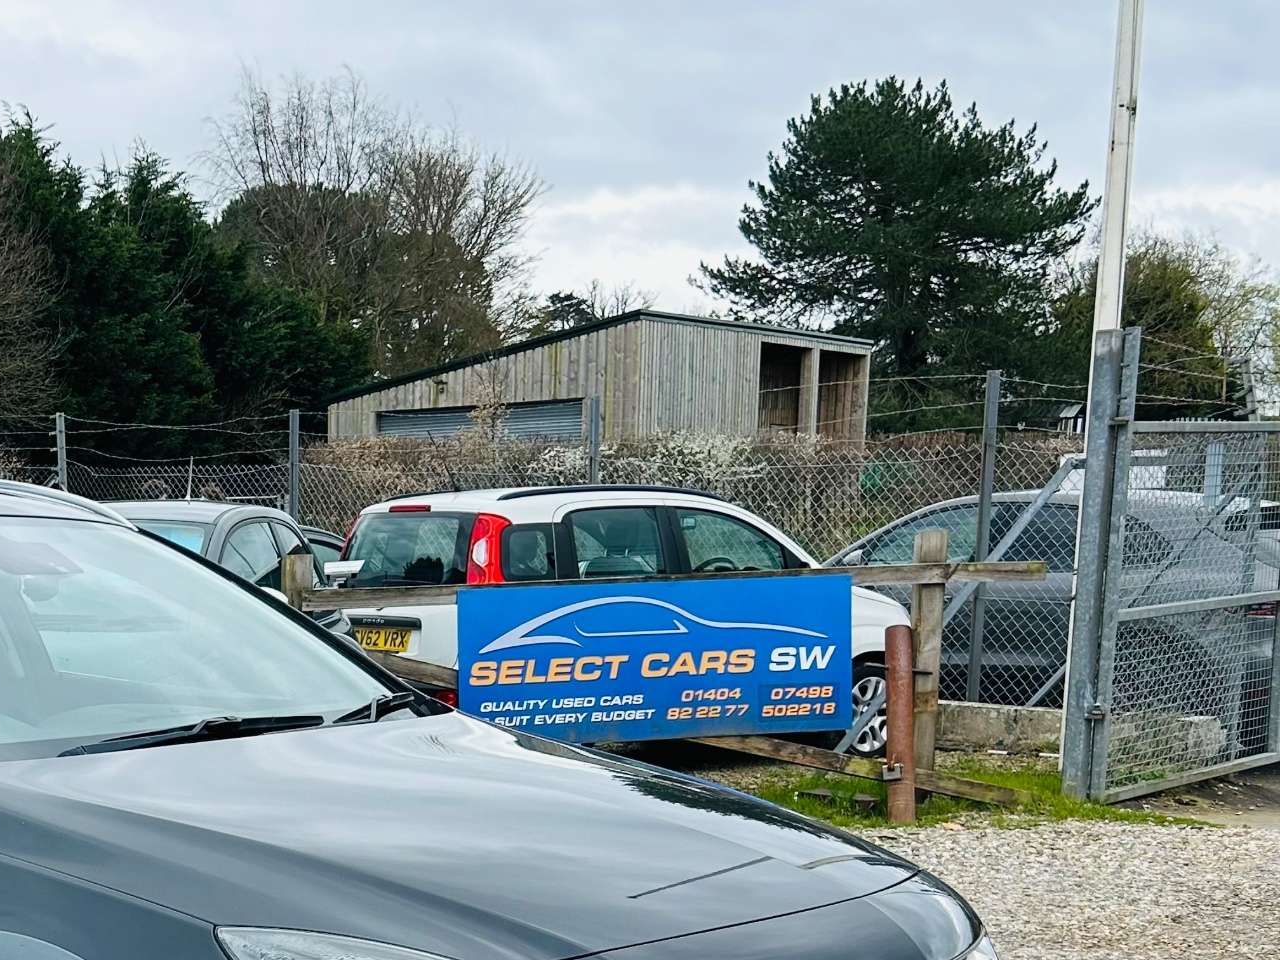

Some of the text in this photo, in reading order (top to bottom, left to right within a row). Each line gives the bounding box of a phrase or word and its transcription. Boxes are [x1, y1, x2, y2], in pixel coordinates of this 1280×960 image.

[383, 631, 408, 648] VRX
[469, 645, 836, 687] SELECT CARS SW
[681, 687, 742, 702] 01404
[771, 686, 834, 700] 07498
[480, 694, 644, 713] QUALITY USED CARS
[761, 702, 837, 717] 502218
[495, 715, 531, 727] SUIT
[534, 712, 588, 725] EVERY
[591, 709, 656, 722] BUDGET
[667, 704, 750, 720] 82 22 77
